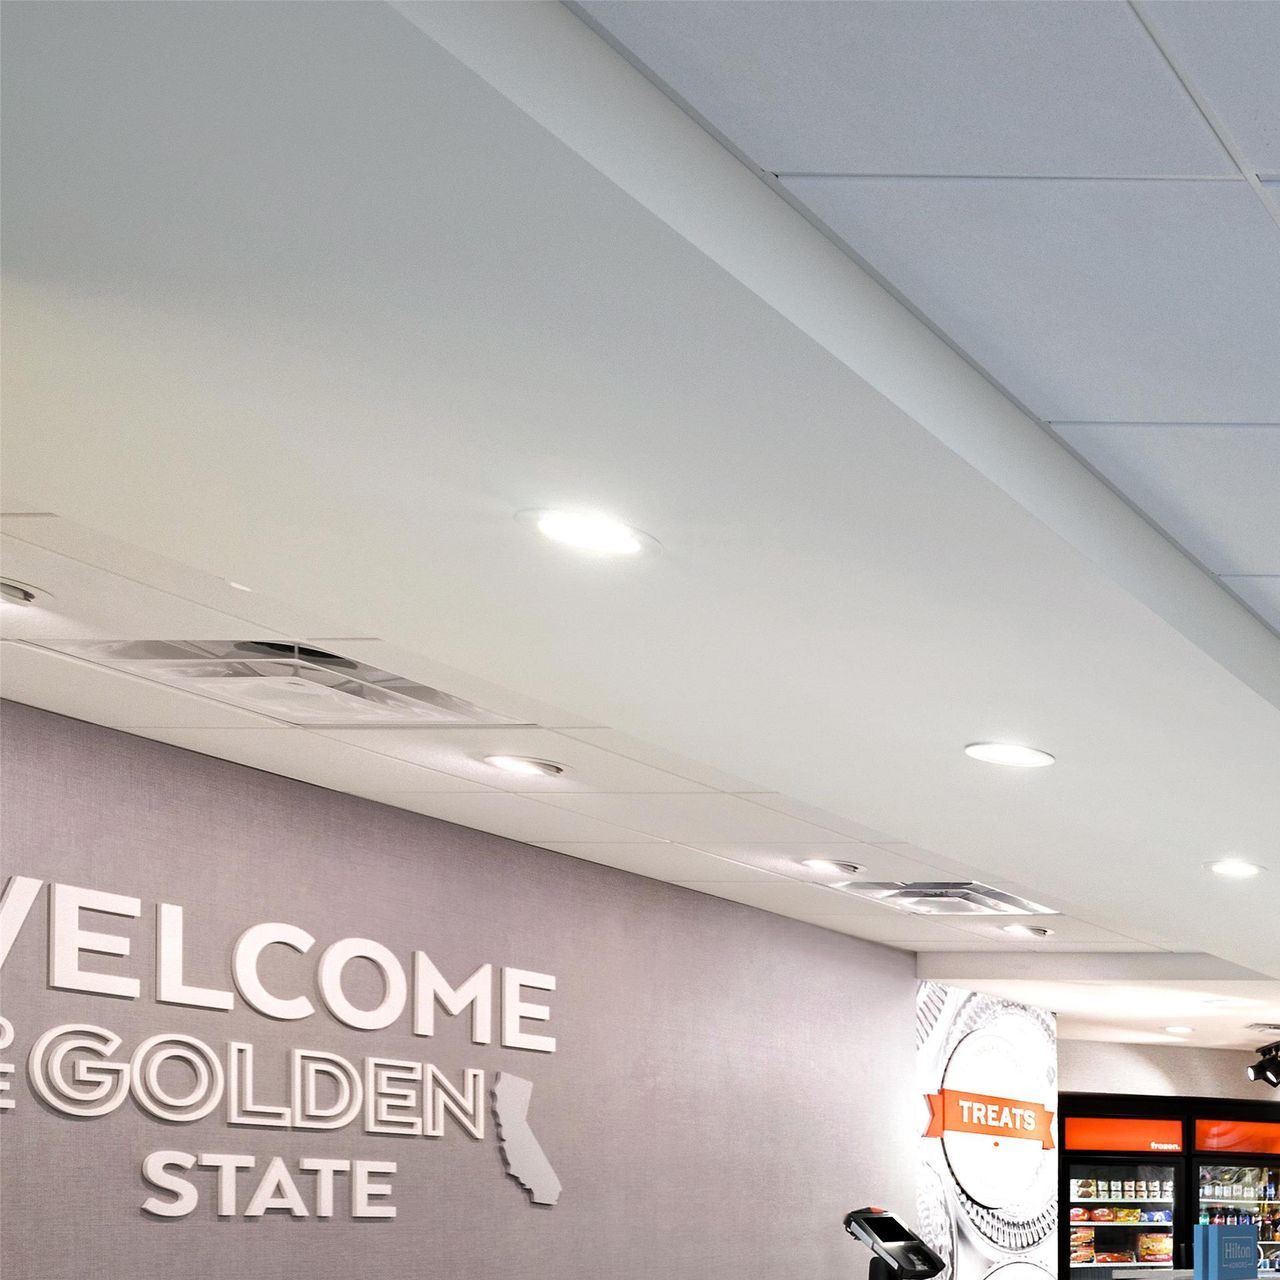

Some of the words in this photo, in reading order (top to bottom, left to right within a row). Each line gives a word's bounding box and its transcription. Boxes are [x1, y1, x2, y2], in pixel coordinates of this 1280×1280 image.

[29, 1023, 484, 1140] GOLDEN
[958, 1100, 1036, 1131] TREATS
[141, 1150, 397, 1218] STATE
[1224, 1242, 1251, 1258] Hilton
